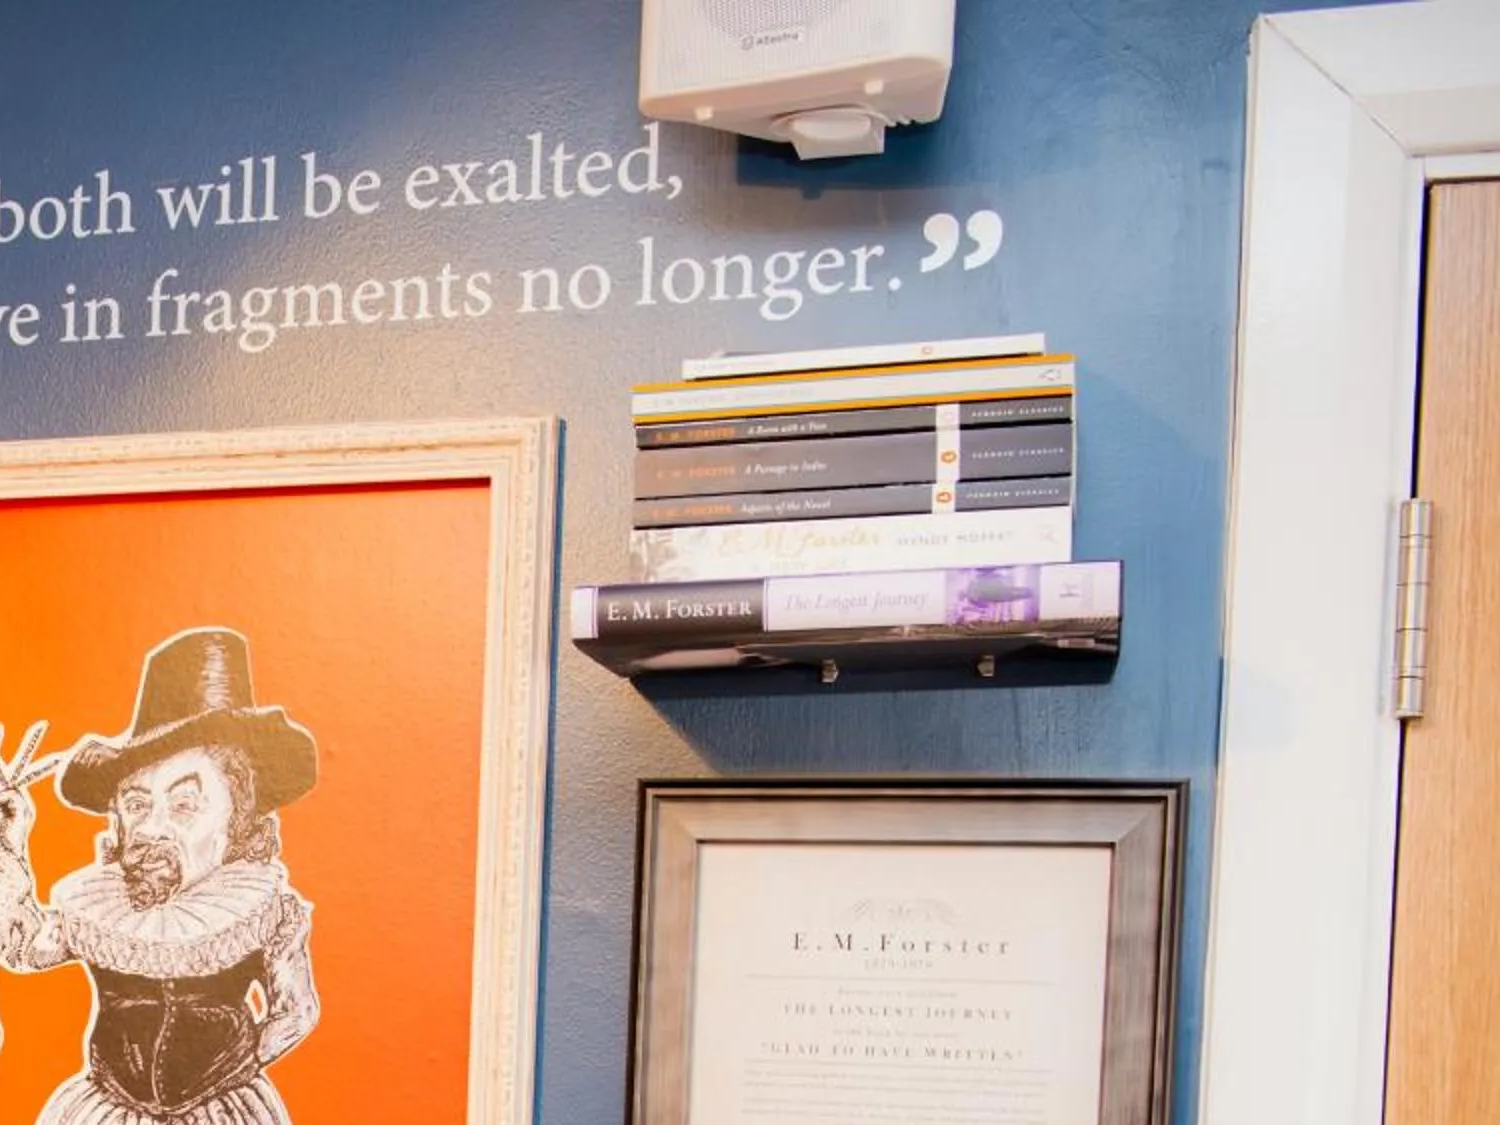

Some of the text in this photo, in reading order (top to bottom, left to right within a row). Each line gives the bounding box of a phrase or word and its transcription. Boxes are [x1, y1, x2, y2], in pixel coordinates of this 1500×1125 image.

[157, 156, 278, 229] will
[301, 152, 380, 217] be
[406, 122, 682, 209] exalted,
[60, 284, 123, 342] in
[146, 264, 489, 351] fragments
[523, 267, 609, 311] no
[607, 598, 752, 621] E. M. FORSTER
[783, 589, 928, 614] The Longest Journey
